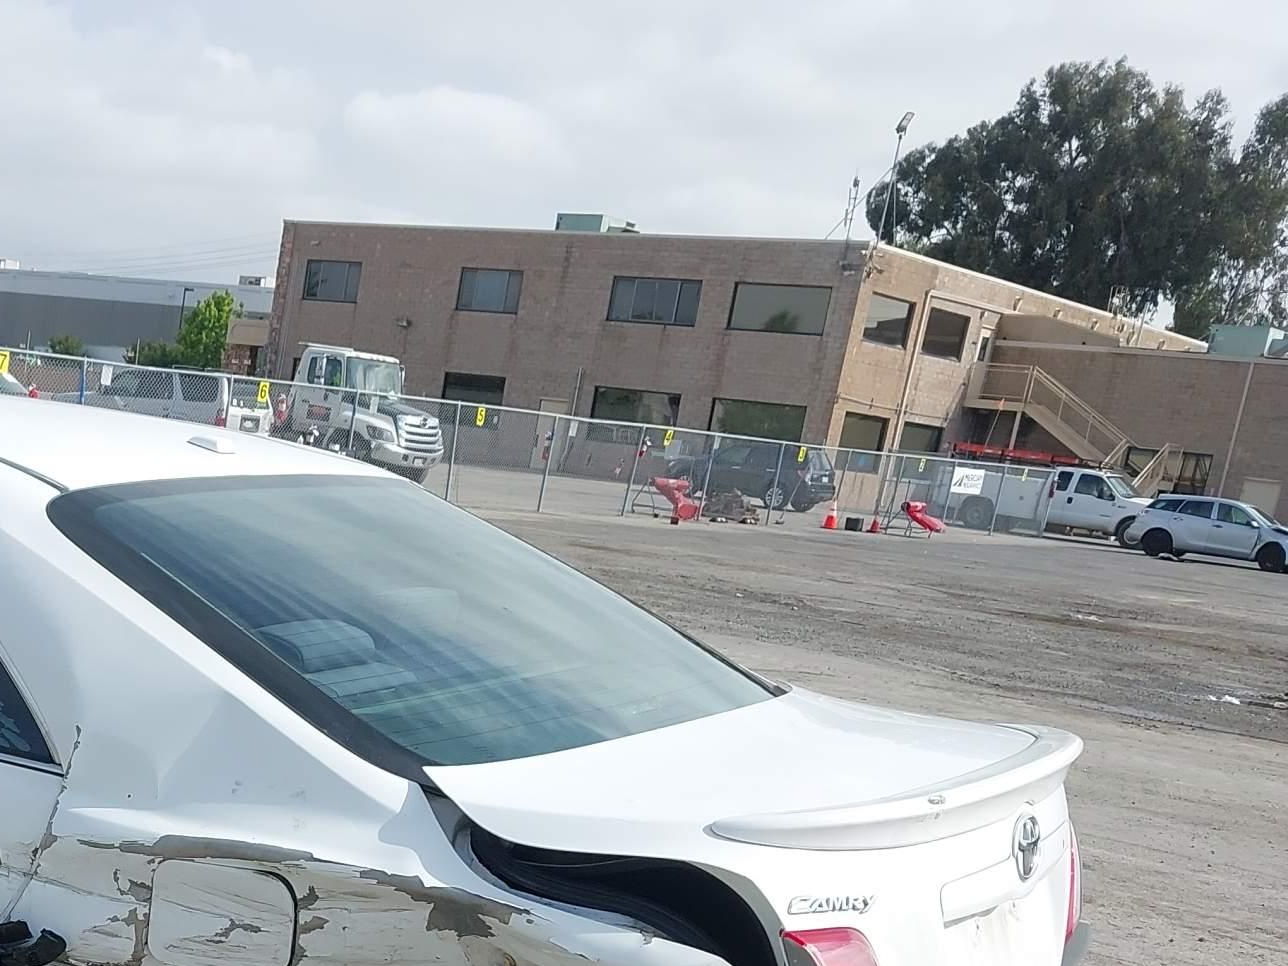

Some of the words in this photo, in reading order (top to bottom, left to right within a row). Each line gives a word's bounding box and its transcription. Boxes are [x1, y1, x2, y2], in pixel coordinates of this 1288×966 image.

[0, 352, 7, 370] 7
[260, 384, 267, 399] 6
[478, 409, 484, 422] 5
[787, 895, 875, 915] CAMRY
